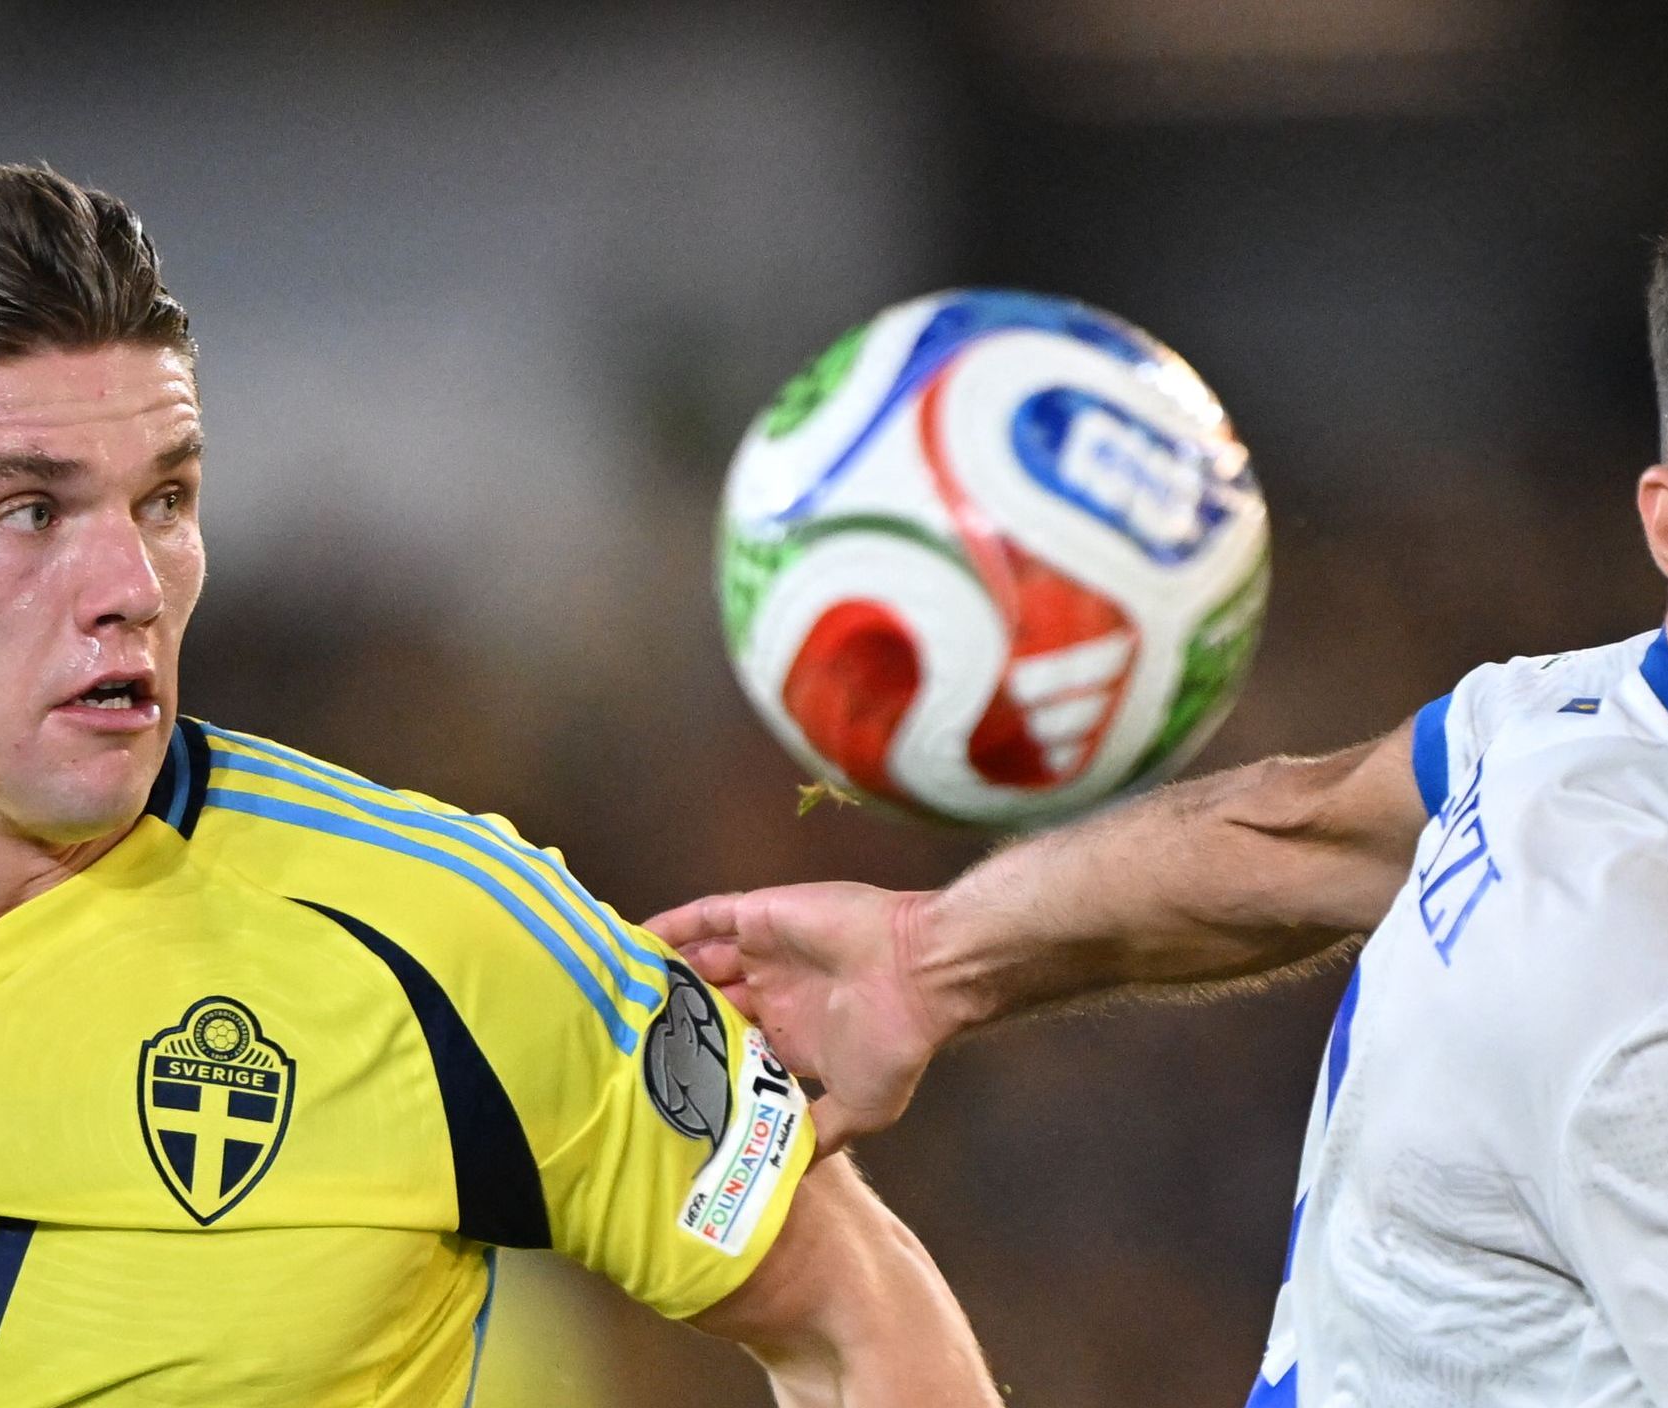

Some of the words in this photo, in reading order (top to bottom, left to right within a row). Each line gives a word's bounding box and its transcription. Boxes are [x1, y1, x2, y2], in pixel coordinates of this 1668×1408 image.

[168, 1061, 266, 1088] SVERIGE
[702, 1103, 777, 1241] FOUNDATION
[683, 1192, 708, 1228] UEFA
